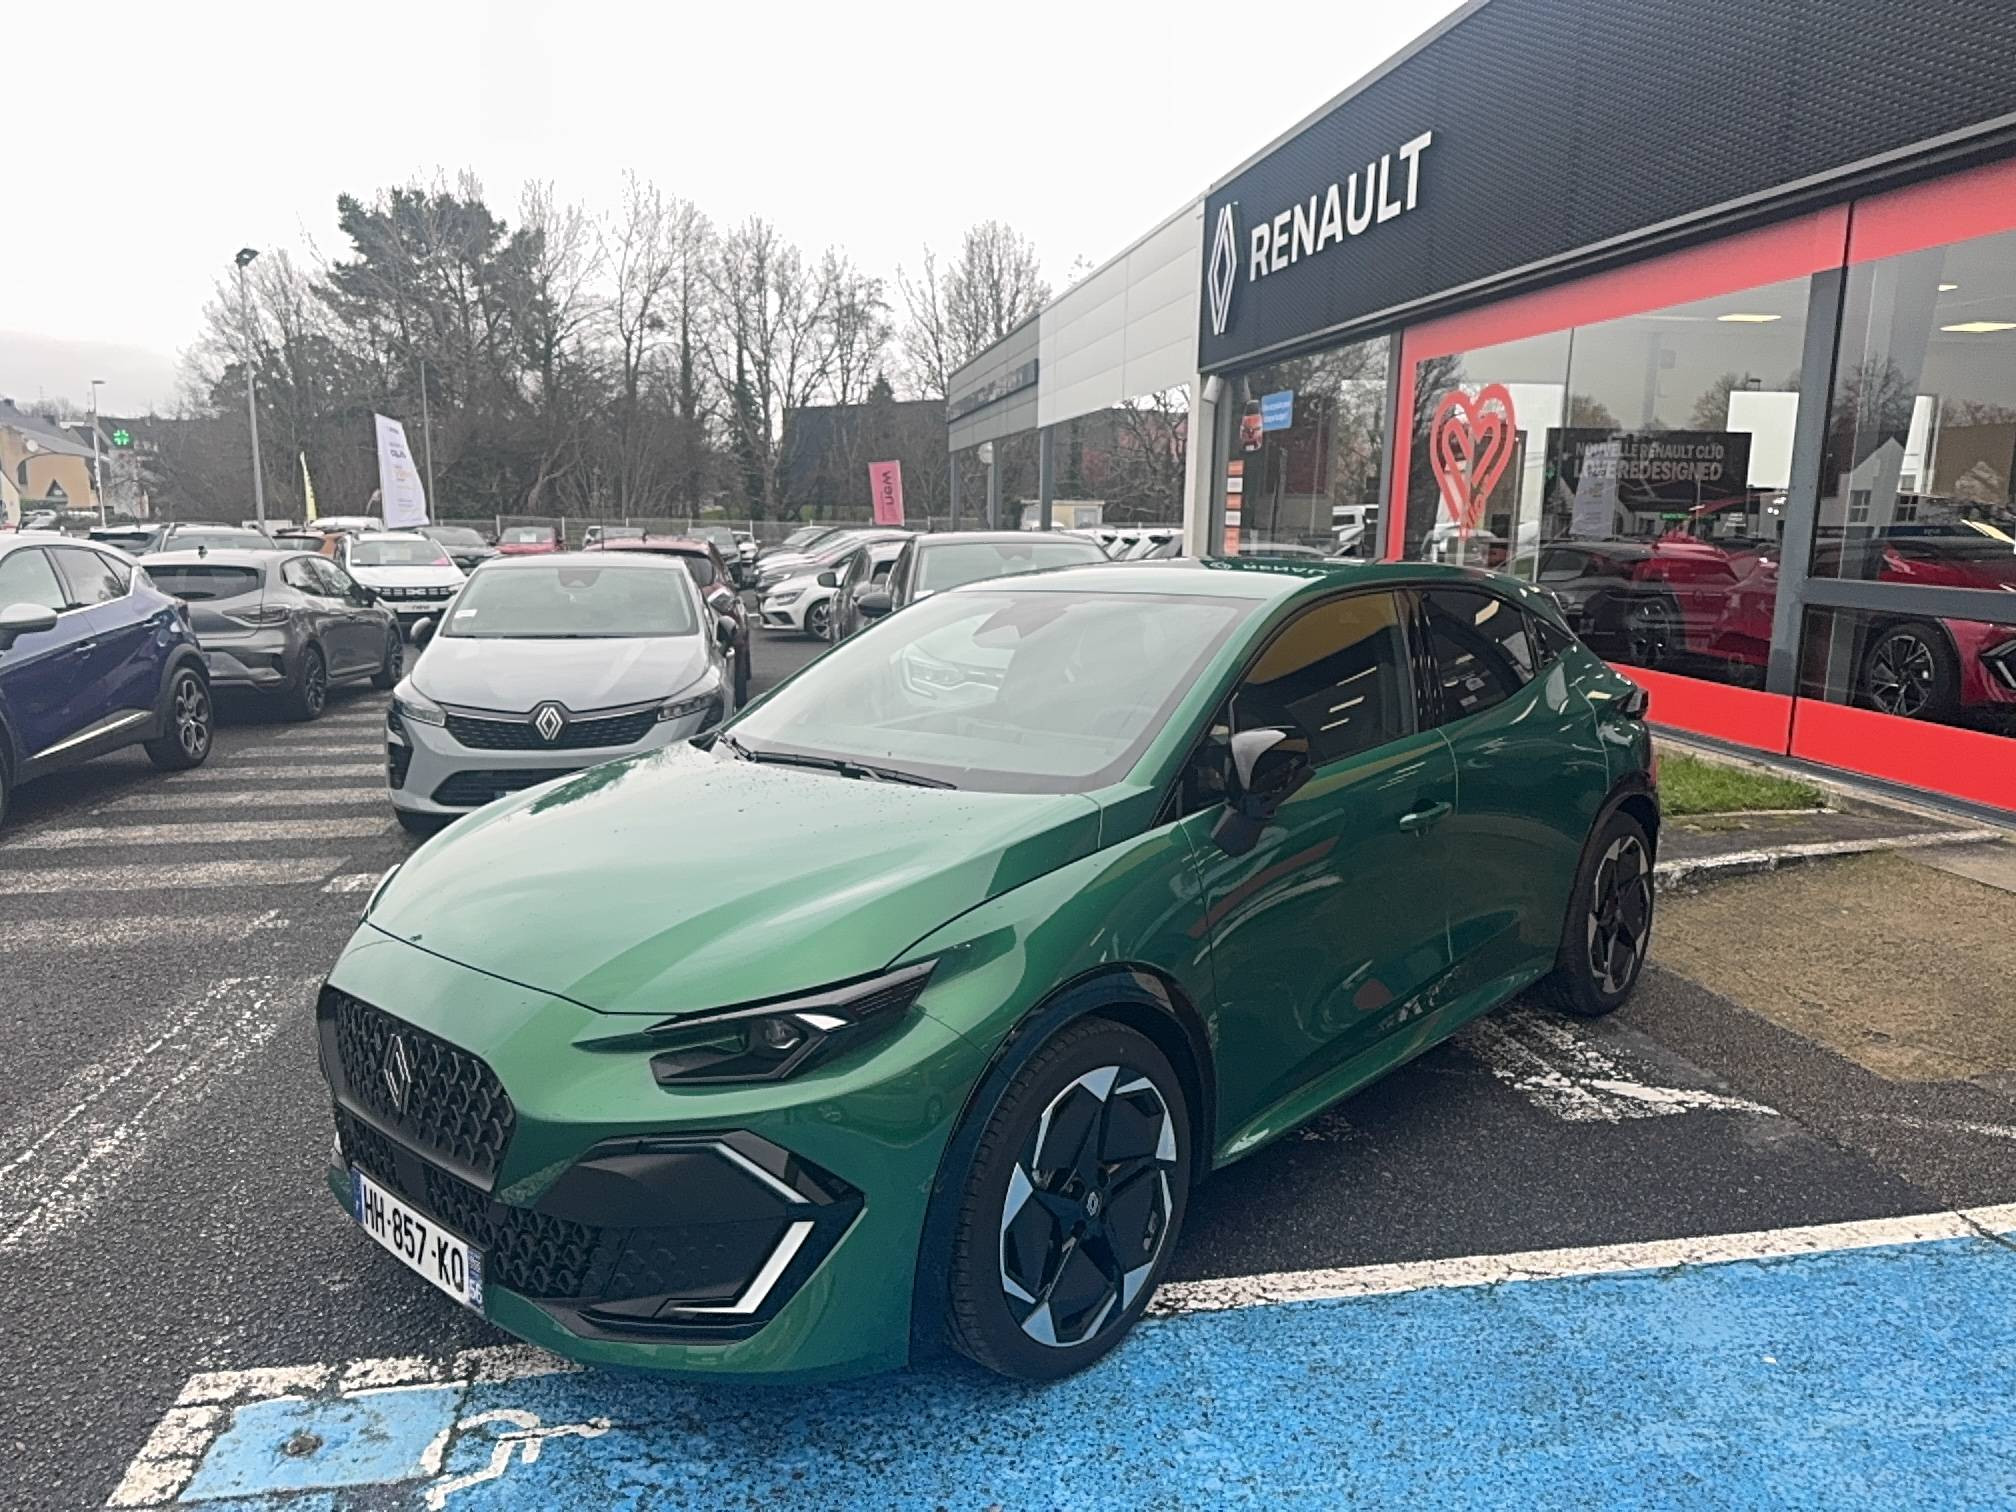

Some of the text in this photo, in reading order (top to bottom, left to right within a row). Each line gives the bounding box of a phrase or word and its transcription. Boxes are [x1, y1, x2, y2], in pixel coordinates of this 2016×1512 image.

[1249, 130, 1432, 282] RENAULT
[1641, 443, 1695, 459] RENAULT
[1695, 445, 1724, 459] CLIO
[1617, 460, 1722, 481] REDESIGNED
